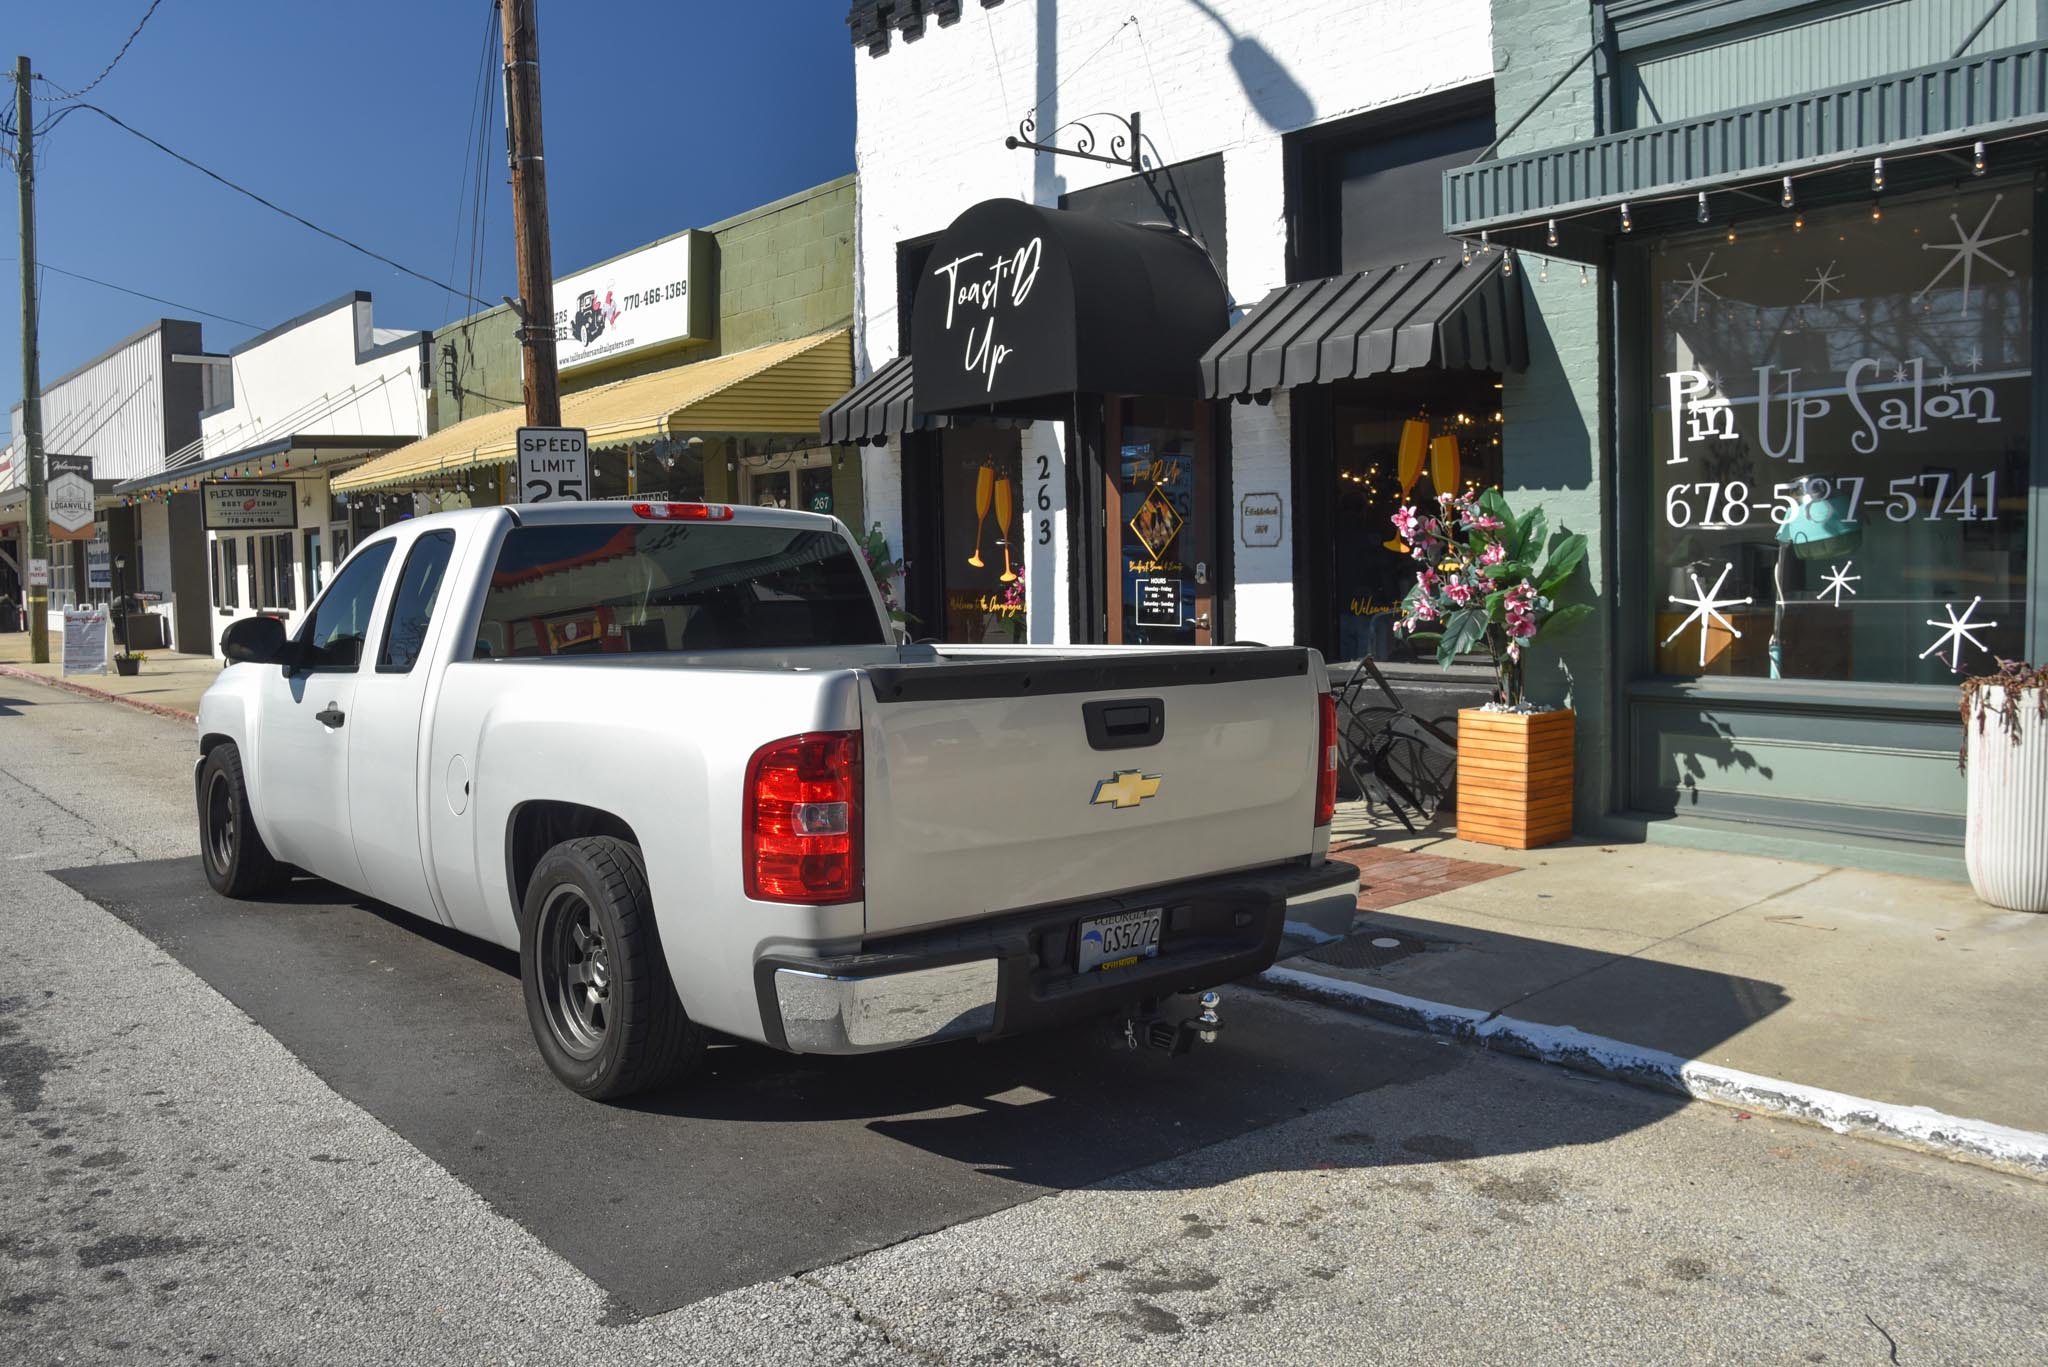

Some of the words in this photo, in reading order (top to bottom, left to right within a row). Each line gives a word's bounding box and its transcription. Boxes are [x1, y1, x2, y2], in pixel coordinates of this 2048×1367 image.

[623, 279, 687, 311] 770-466-1369
[934, 237, 1042, 330] Toast'D
[965, 316, 1013, 393] Up
[1665, 370, 1739, 465] Pin
[1752, 364, 1831, 464] Up
[1845, 357, 2003, 454] Salon
[523, 438, 582, 453] SPEED
[531, 459, 576, 473] LIMIT
[210, 488, 234, 499] FLEX
[235, 488, 260, 497] BODY
[262, 488, 288, 499] SHOP
[526, 479, 582, 502] 25
[814, 496, 829, 510] 267
[1036, 454, 1052, 546] 263
[1665, 470, 2000, 528] 678-587-5741
[51, 502, 92, 511] LOGANVILLE
[1350, 595, 1390, 615] Welcome
[1103, 918, 1159, 953] GS5272
